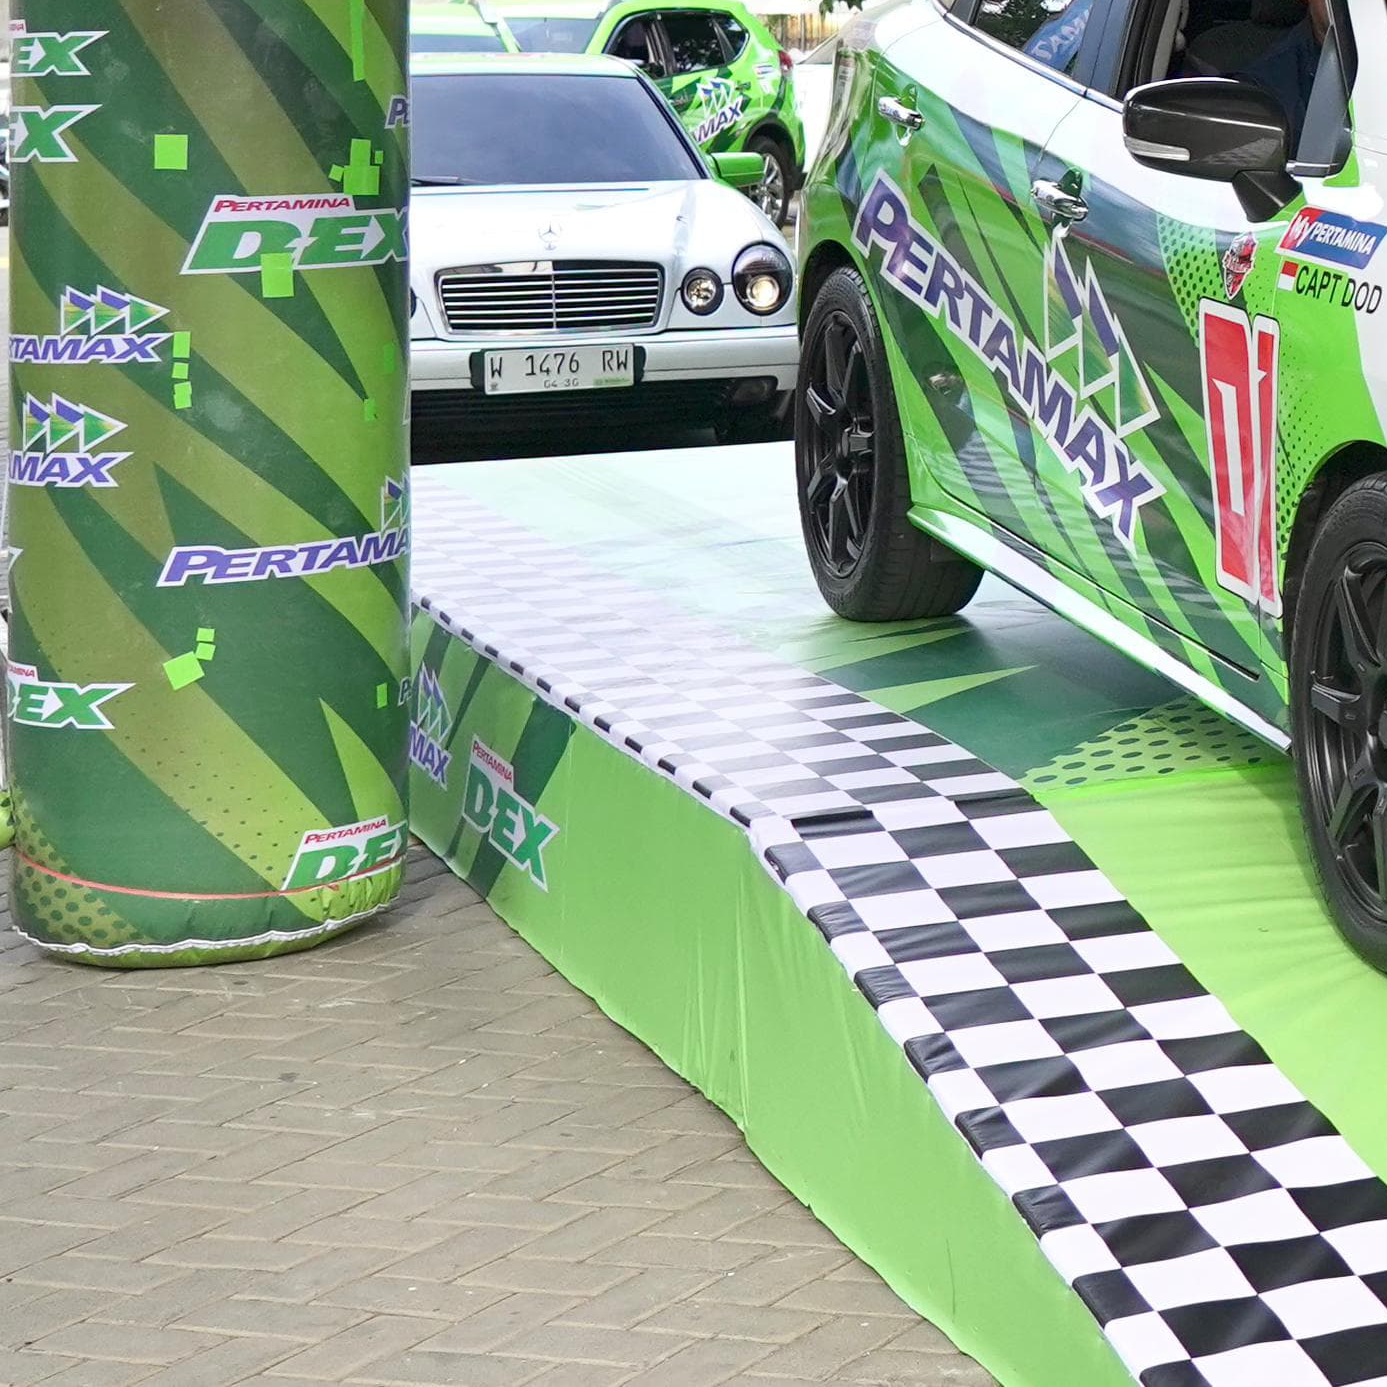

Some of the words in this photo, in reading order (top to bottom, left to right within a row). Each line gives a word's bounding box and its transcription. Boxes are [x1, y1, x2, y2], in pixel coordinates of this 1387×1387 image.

[213, 197, 351, 213] PERTAMINA
[1295, 265, 1343, 304] CAPT
[1341, 278, 1383, 315] DOD
[490, 355, 504, 379] W
[524, 351, 581, 377] 1476
[602, 349, 629, 373] RW
[855, 179, 1157, 540] PERTAMAX
[472, 740, 513, 782] PERTAMINA
[304, 818, 387, 845] PERTAMINA
[464, 765, 553, 885] DEX
